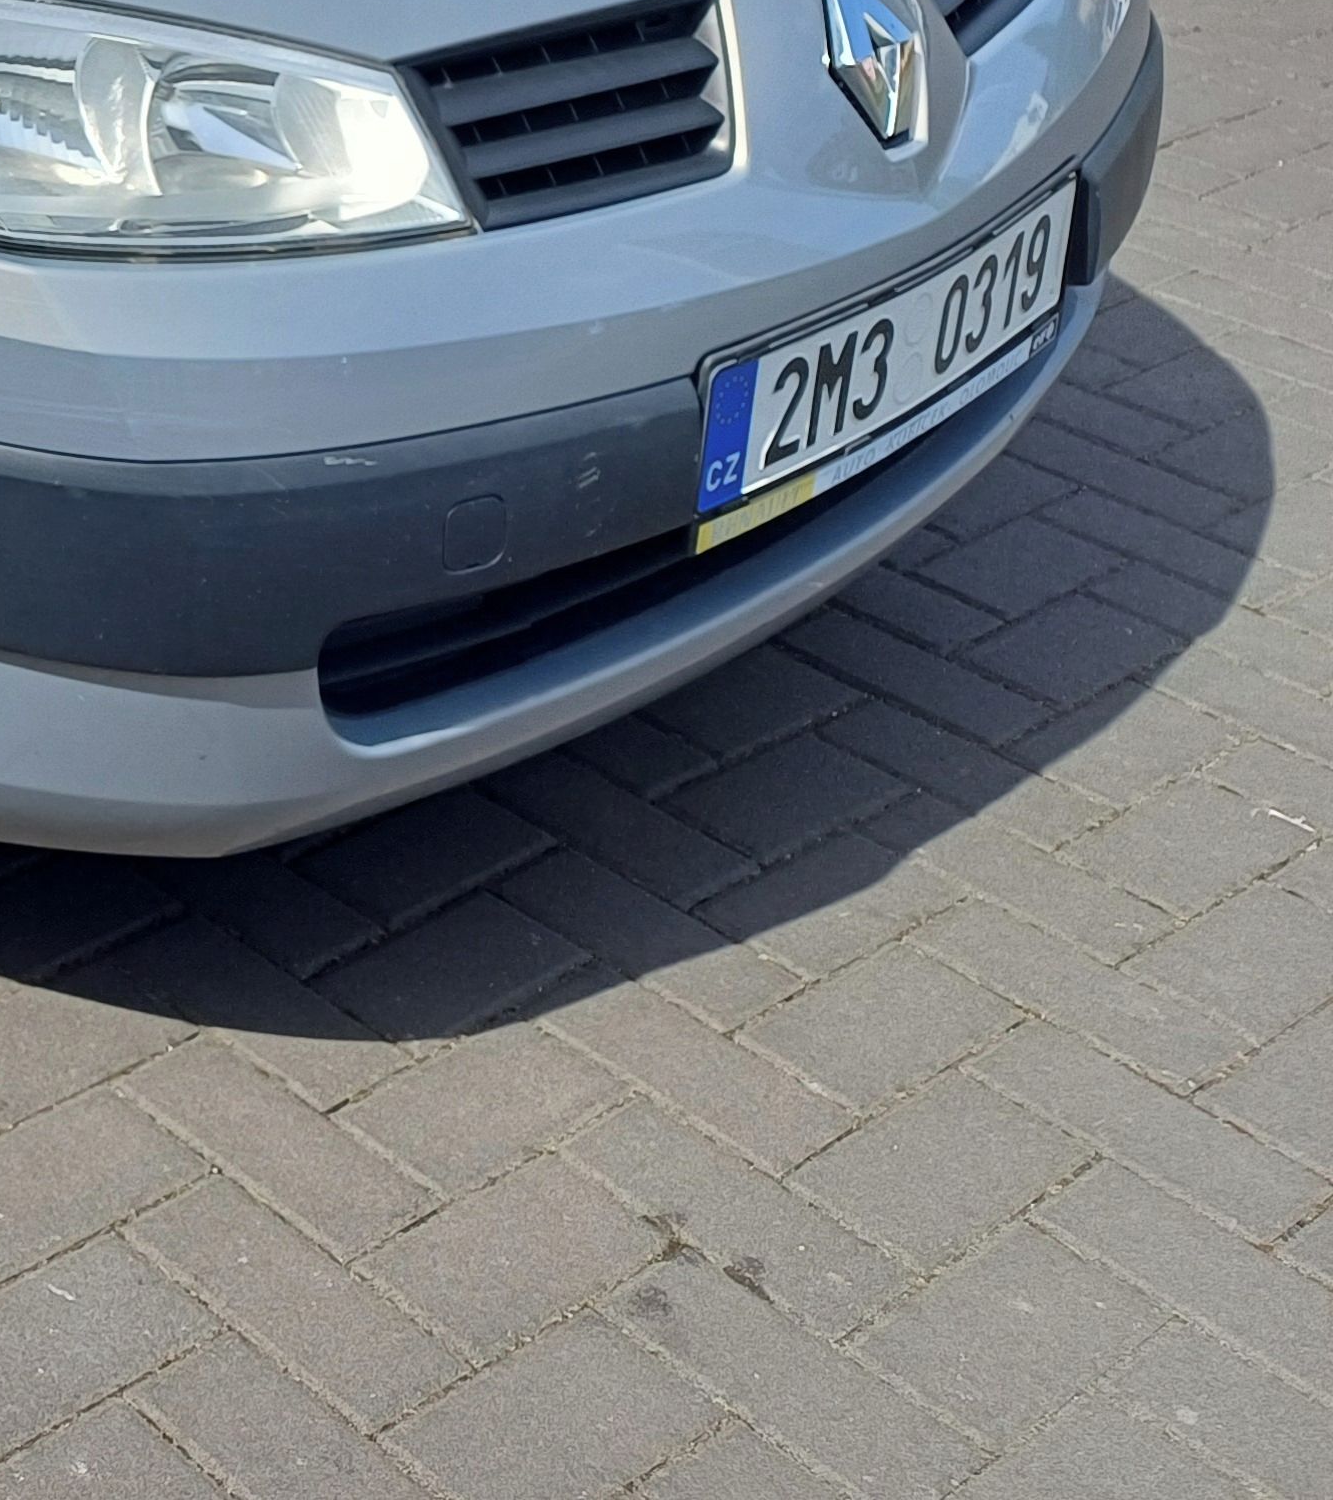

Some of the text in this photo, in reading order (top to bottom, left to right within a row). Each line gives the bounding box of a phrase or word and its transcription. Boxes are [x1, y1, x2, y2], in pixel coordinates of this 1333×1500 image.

[763, 214, 1052, 470] 2M3 0319
[705, 450, 741, 493] CZ
[831, 447, 876, 484] AUTO
[958, 348, 1024, 406] OLOMOUC
